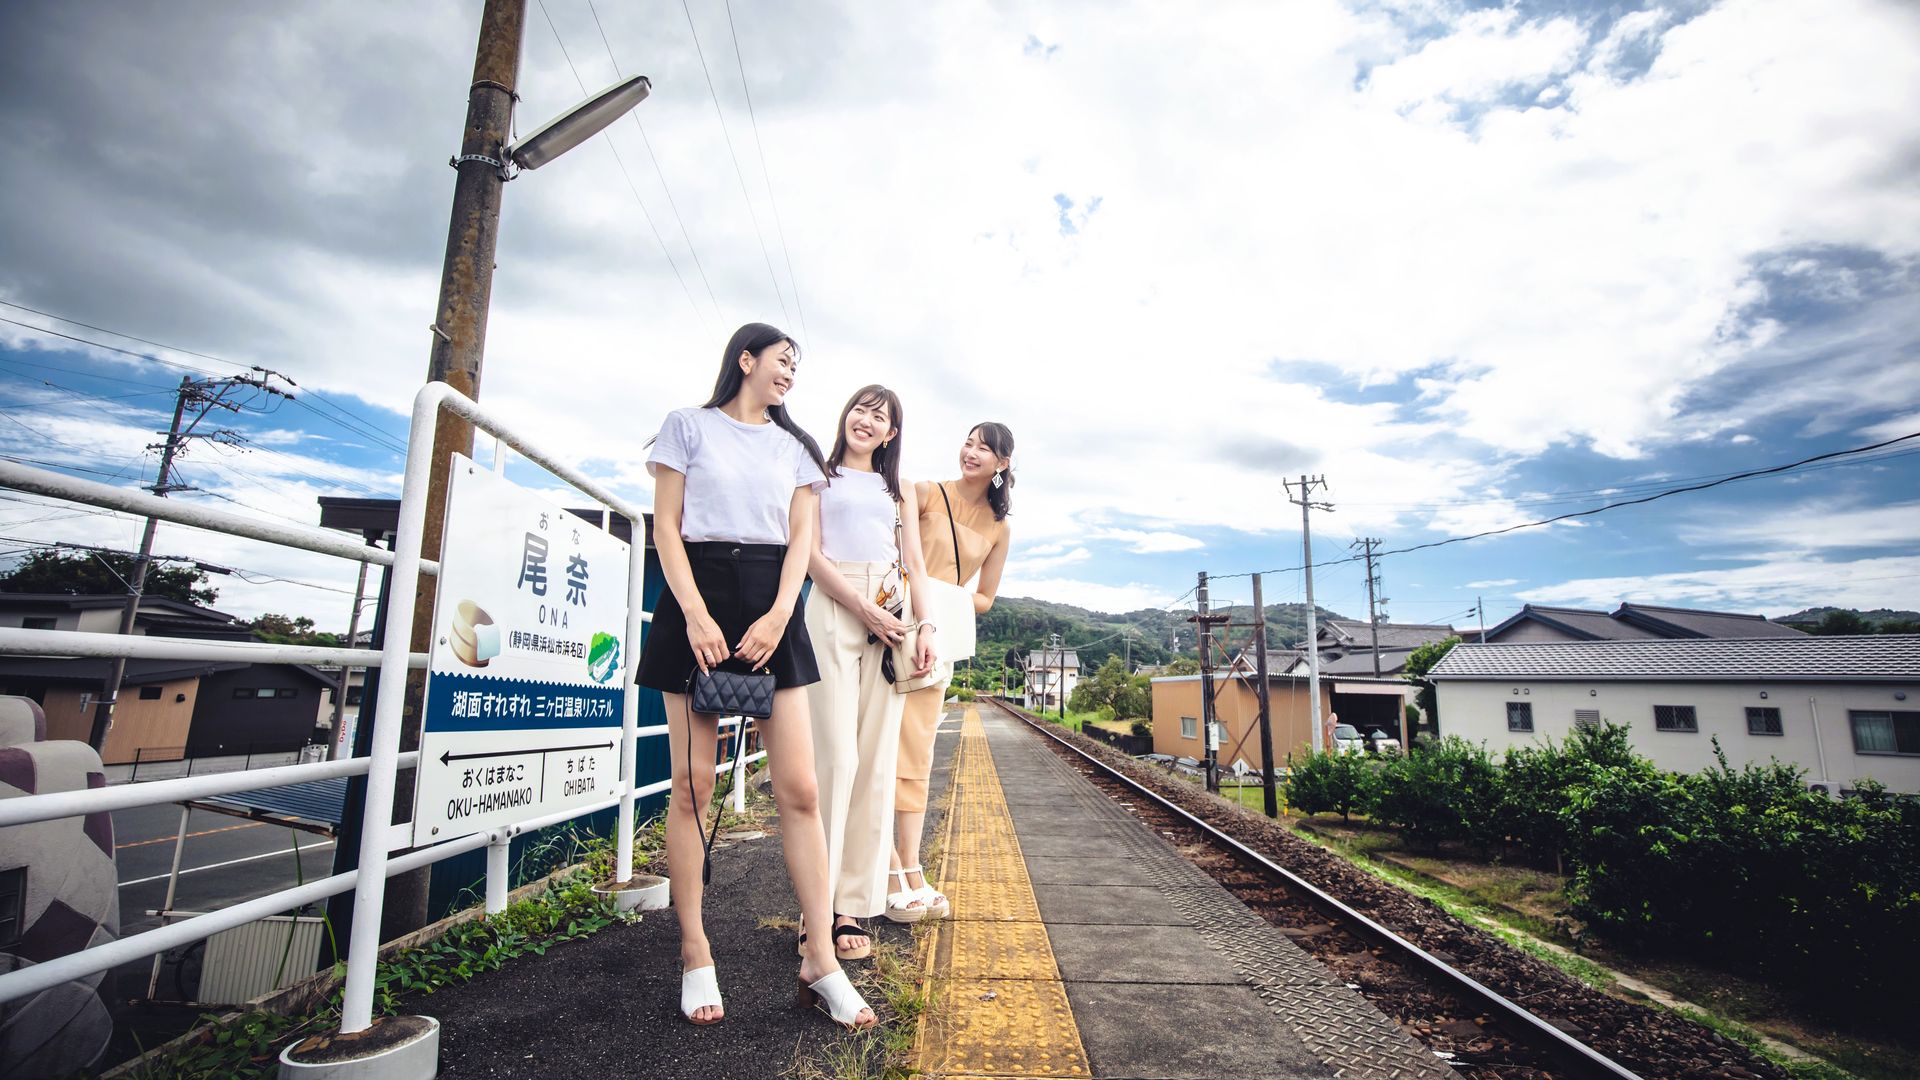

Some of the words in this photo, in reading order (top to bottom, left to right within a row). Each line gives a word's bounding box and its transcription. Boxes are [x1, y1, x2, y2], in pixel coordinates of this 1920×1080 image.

[539, 511, 580, 545] おな
[517, 531, 589, 607] 尾奈
[538, 604, 568, 629] ONA
[509, 630, 586, 659] (静岡県浜松市浜名区)
[451, 690, 531, 719] 湖面すれすれ
[462, 764, 524, 788] おくはまなこ
[566, 755, 596, 774] ちばた
[563, 777, 595, 797] CHIBATA
[447, 787, 533, 820] OKU-HAMANAKO
